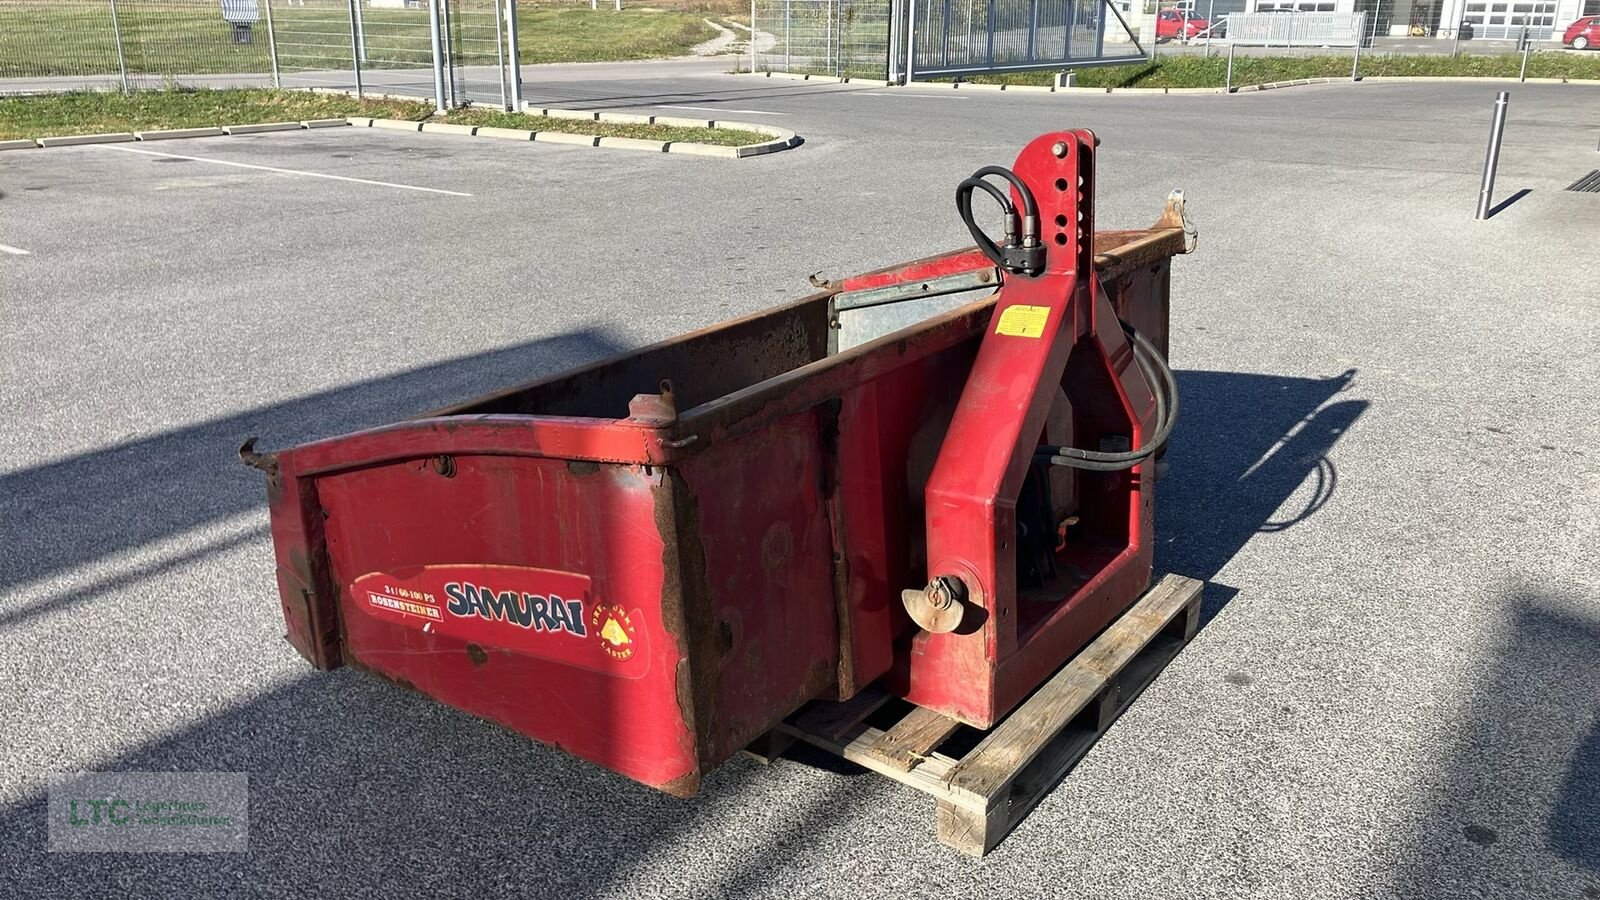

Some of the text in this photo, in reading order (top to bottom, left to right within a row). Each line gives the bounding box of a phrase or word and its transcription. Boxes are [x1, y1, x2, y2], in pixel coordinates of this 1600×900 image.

[370, 594, 440, 618] ROSENSTEINER
[444, 582, 587, 638] SAMURAI
[600, 641, 632, 659] LASTER
